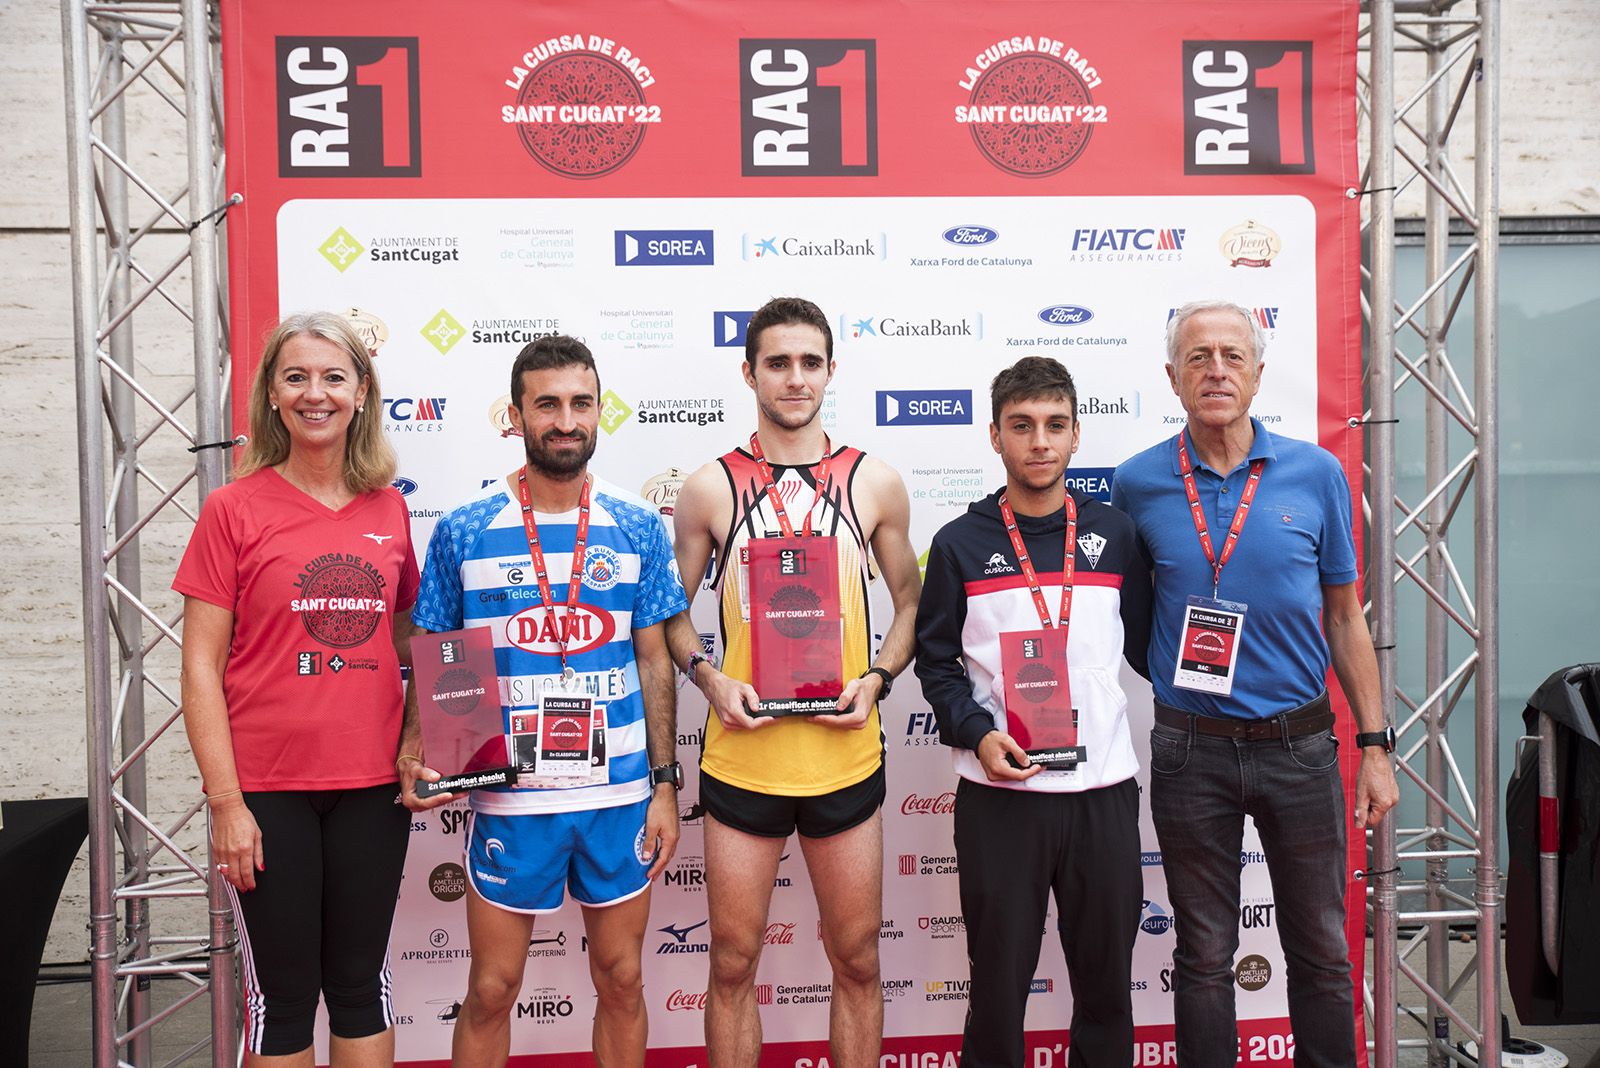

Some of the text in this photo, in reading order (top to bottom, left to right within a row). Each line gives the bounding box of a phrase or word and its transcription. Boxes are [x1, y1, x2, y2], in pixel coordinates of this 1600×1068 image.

[505, 66, 529, 90] LA
[523, 34, 586, 68] CURSA
[588, 35, 615, 56] DE
[959, 67, 982, 91] LA
[976, 36, 1035, 70] CURSA
[1037, 37, 1064, 57] DE
[287, 47, 411, 167] RAC 1
[750, 49, 867, 166] RAC 1
[1192, 50, 1305, 165] RAC 1
[502, 105, 556, 123] SANT
[955, 106, 1007, 122] SANT
[371, 237, 458, 247] AJUNTAMENT DE
[950, 227, 988, 244] Ford
[648, 240, 705, 256] SOREA
[782, 238, 875, 257] CaixaBank
[371, 248, 459, 264] SantCugat
[911, 256, 1033, 268] Xarxa Ford de Catalunya
[1070, 253, 1182, 262] ASSEGURANCES
[600, 309, 631, 318] Hospital
[1049, 307, 1084, 325] Ford
[473, 319, 559, 329] AJUNTAMENT DE
[630, 318, 674, 328] General
[880, 318, 971, 338] CaixaBank
[600, 330, 674, 342] de Catalunya
[1006, 336, 1127, 348] Xarxa Ford de Catalunya
[638, 399, 723, 409] AJUNTAMENT DE
[908, 399, 965, 416] SOREA
[1079, 396, 1129, 415] aBank
[638, 409, 724, 426] SantCugat
[912, 467, 983, 477] Hospital Universitari
[942, 476, 983, 487] General
[913, 488, 984, 501] de Catalunya
[781, 549, 794, 574] RAC
[293, 572, 309, 589] LA
[304, 552, 342, 572] CURSA
[346, 553, 362, 565] DE
[291, 599, 328, 612] SANT
[765, 609, 786, 618] SANT
[1199, 614, 1217, 622] CURSA
[1217, 617, 1226, 625] DE
[517, 614, 593, 644] DANI
[441, 642, 454, 664] RAC
[1024, 640, 1034, 658] RAC
[299, 652, 311, 675] RAC
[432, 692, 451, 702] SANT
[769, 700, 810, 710] Classificat
[439, 776, 478, 790] Classificat
[478, 772, 506, 784] absolut
[921, 855, 956, 865] Genera
[921, 866, 933, 875] de
[433, 878, 465, 886] AMETLLER
[664, 870, 707, 887] MIR
[433, 885, 465, 894] ORIGEN
[1242, 903, 1274, 929] ORT
[401, 949, 472, 960] APROPERTIE
[1239, 969, 1268, 977] AMETLLER
[1239, 976, 1268, 985] ORIGEN
[776, 984, 832, 994] Generalitat
[776, 994, 833, 1005] de Catalun
[926, 992, 969, 1002] EXPERIEN
